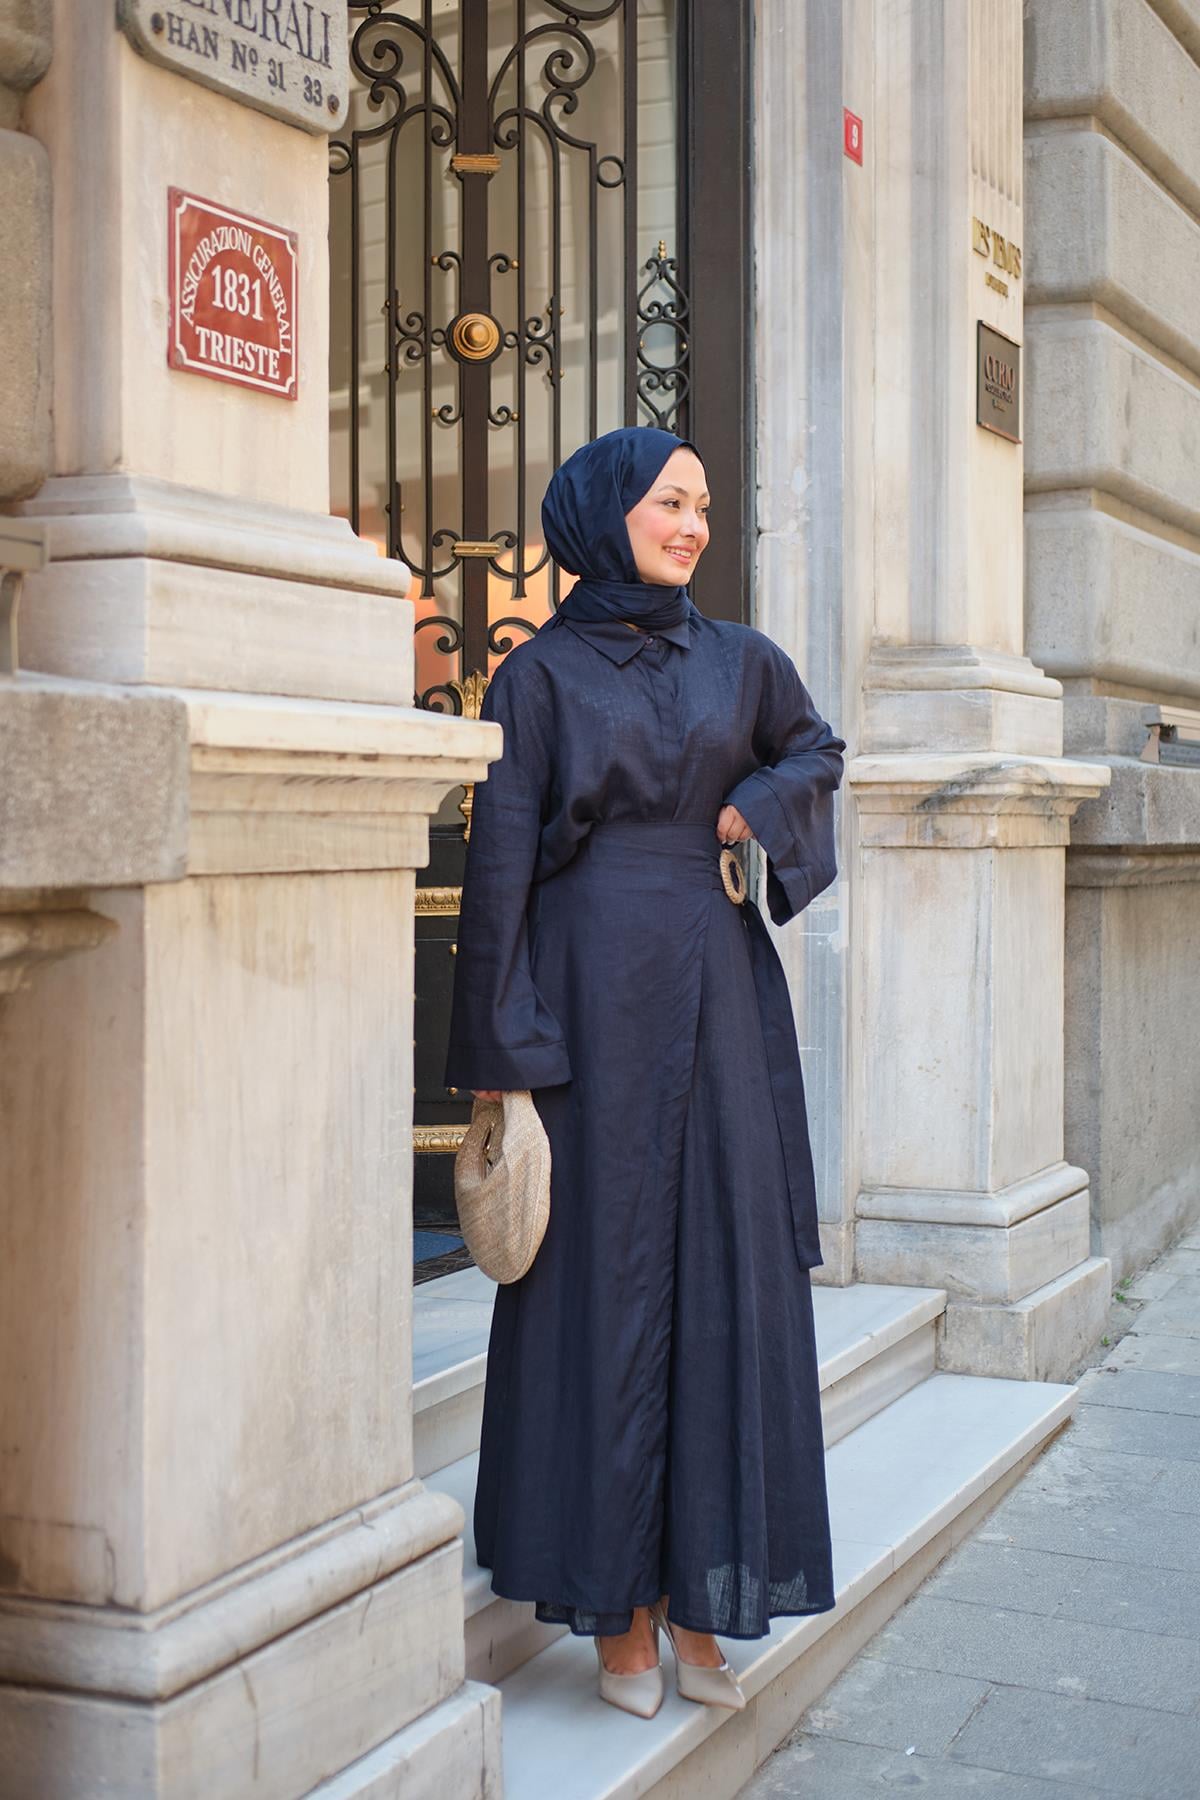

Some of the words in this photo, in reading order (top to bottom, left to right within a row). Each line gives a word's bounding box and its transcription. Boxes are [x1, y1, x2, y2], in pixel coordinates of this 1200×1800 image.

[166, 12, 219, 61] HAN
[268, 58, 286, 92] 31
[303, 75, 323, 107] 33
[181, 226, 253, 327] ASSICURAZIONI
[252, 244, 292, 355] GENERALI
[211, 265, 264, 321] 1831
[195, 325, 281, 380] TRIESTE
